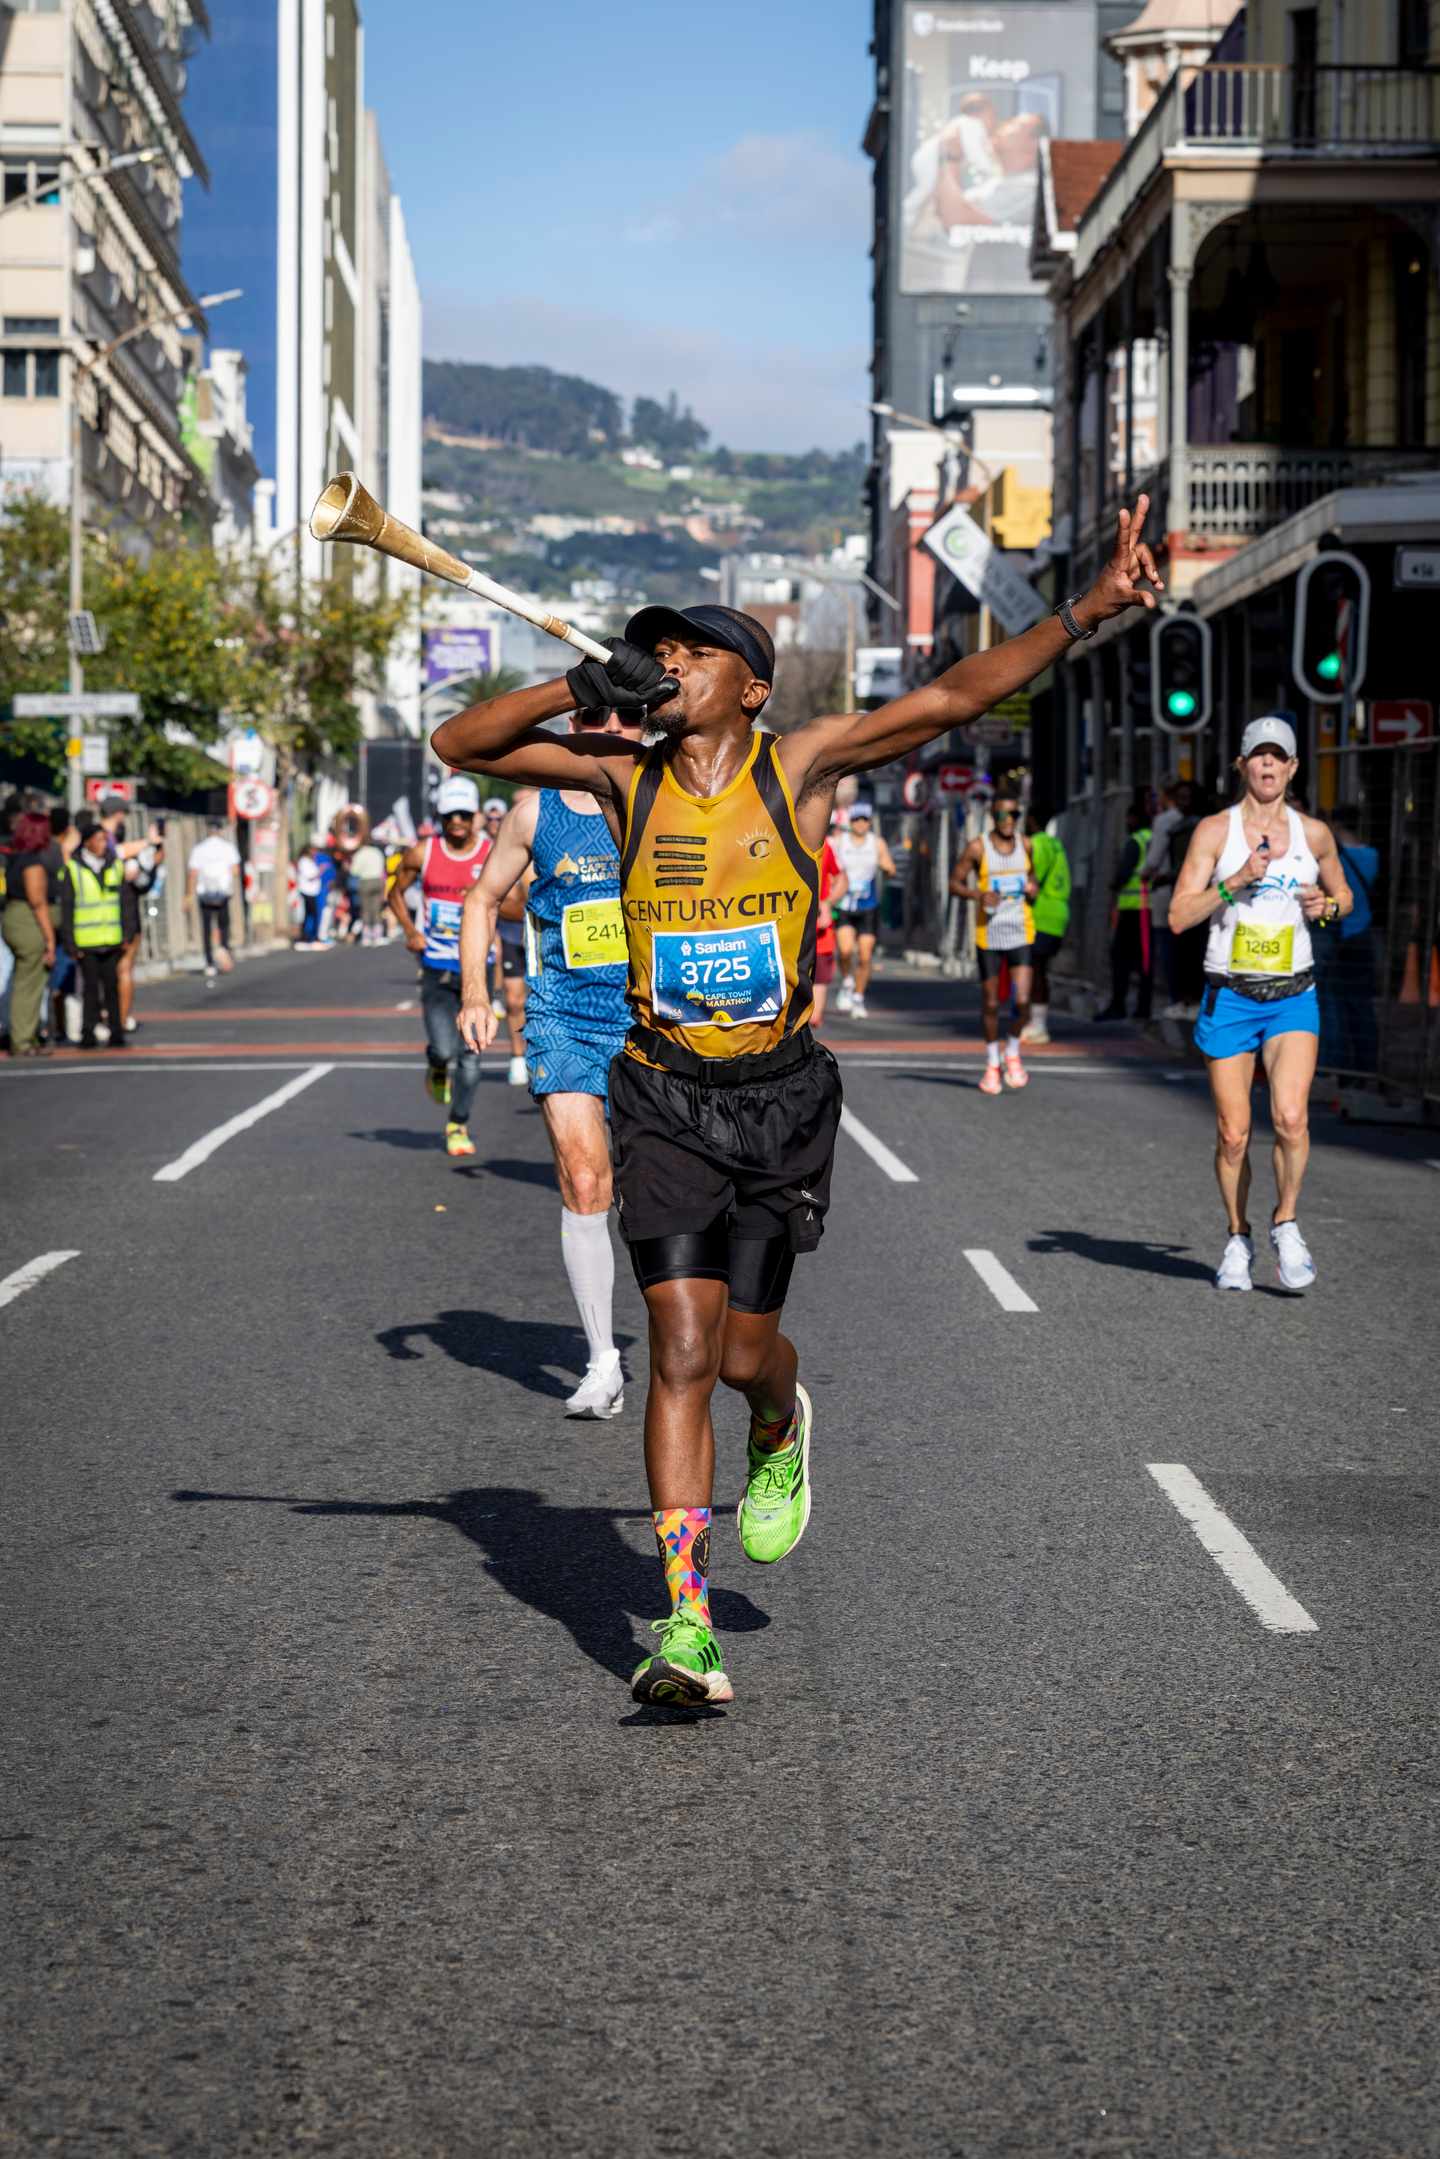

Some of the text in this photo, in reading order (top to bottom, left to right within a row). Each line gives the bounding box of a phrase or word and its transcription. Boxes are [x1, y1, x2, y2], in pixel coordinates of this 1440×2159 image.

[969, 55, 1030, 81] Keep
[625, 896, 735, 922] CENTURY
[737, 890, 799, 916] CITY
[695, 939, 747, 955] Sanlam
[1245, 940, 1281, 955] 1263
[680, 956, 751, 985] 3725
[705, 992, 726, 1002] CAPE
[727, 989, 752, 999] TOWN
[705, 996, 752, 1008] MARATHON
